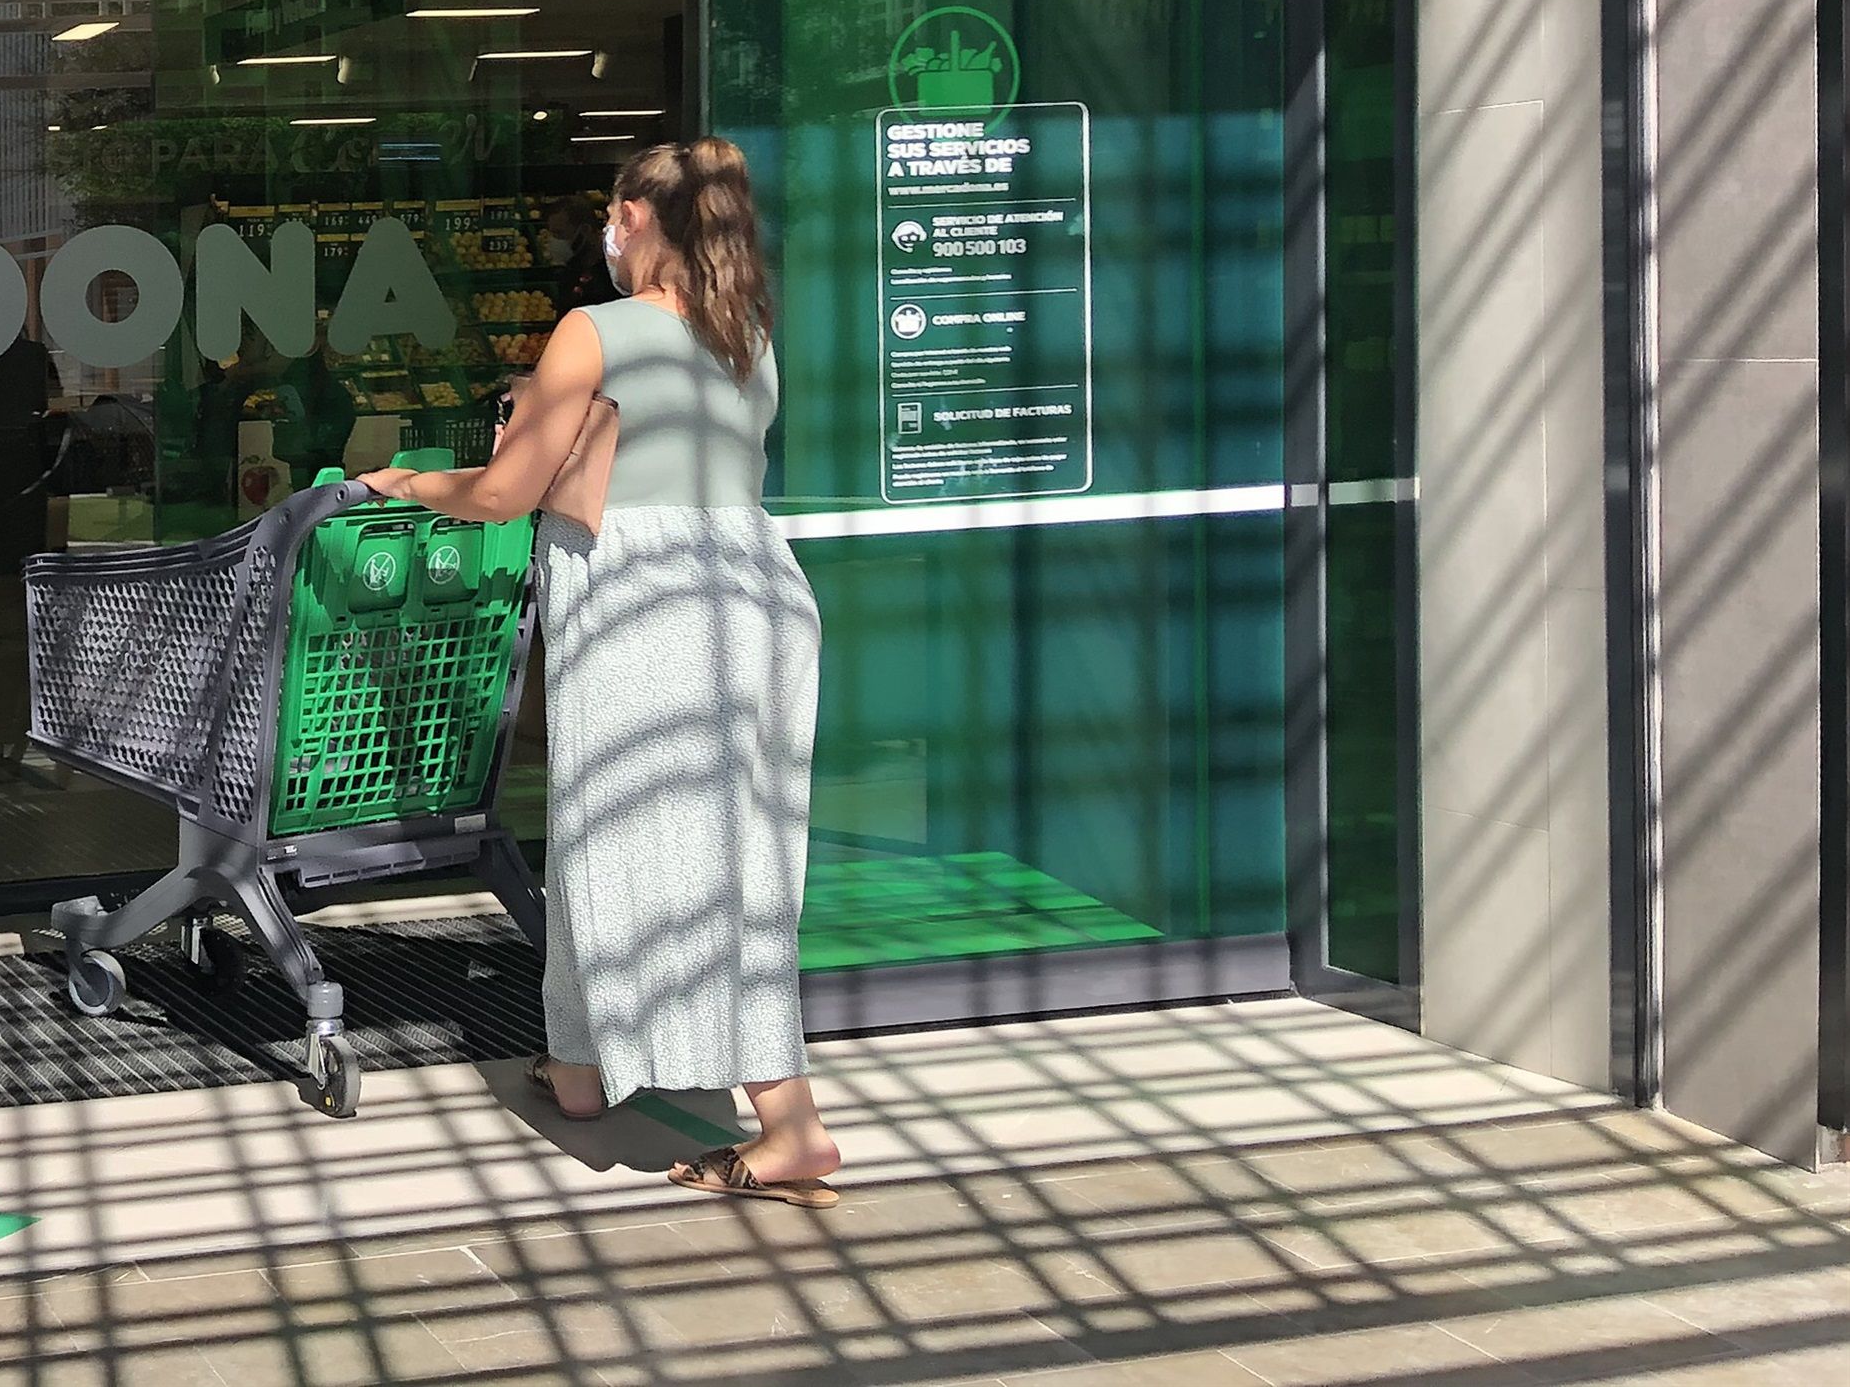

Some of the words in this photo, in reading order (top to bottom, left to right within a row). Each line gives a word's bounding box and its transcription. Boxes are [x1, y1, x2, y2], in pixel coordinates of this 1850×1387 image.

[886, 122, 984, 140] GESTIONE
[887, 143, 926, 159] SUS
[929, 138, 1031, 157] SERVICIOS
[887, 162, 904, 178] A
[907, 156, 982, 176] TRAVÉS
[984, 158, 1014, 174] DE
[932, 215, 986, 226] SERVICIO
[987, 214, 1004, 224] DE
[932, 227, 948, 238] AL
[950, 226, 998, 237] CLIENTE
[932, 242, 964, 257] 900
[965, 240, 996, 256] 500
[997, 238, 1027, 254] 103
[932, 314, 982, 326] COMPRA
[982, 311, 1027, 324] ONLINE
[933, 410, 994, 422] SOLICITUD
[994, 408, 1011, 418] DE
[1012, 404, 1073, 418] FACTURAS
